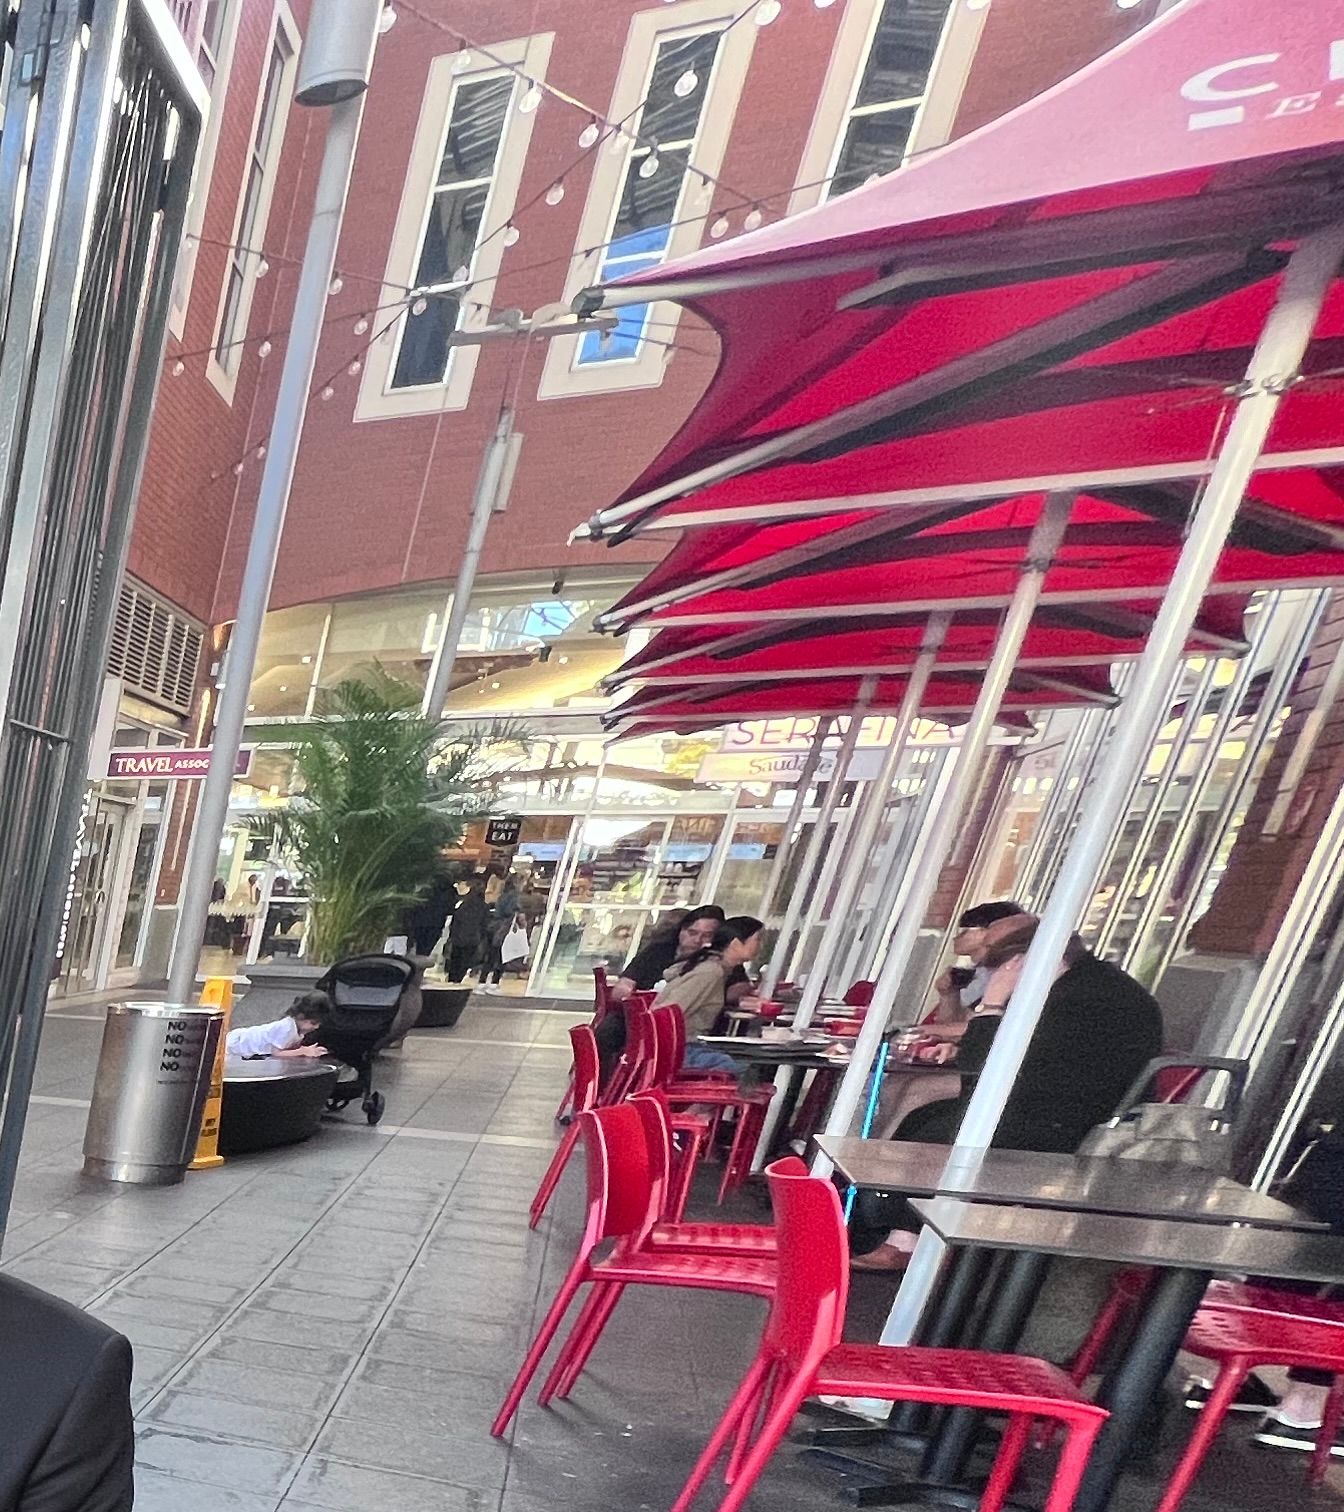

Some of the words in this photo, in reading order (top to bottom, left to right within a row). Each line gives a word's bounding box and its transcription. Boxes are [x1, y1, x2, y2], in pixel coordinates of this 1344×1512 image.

[116, 756, 173, 773] TRAVEL
[175, 758, 210, 769] ASSOC
[167, 1021, 188, 1031] NO
[165, 1034, 185, 1045] NO
[162, 1048, 182, 1058] NO
[159, 1061, 180, 1072] NO
